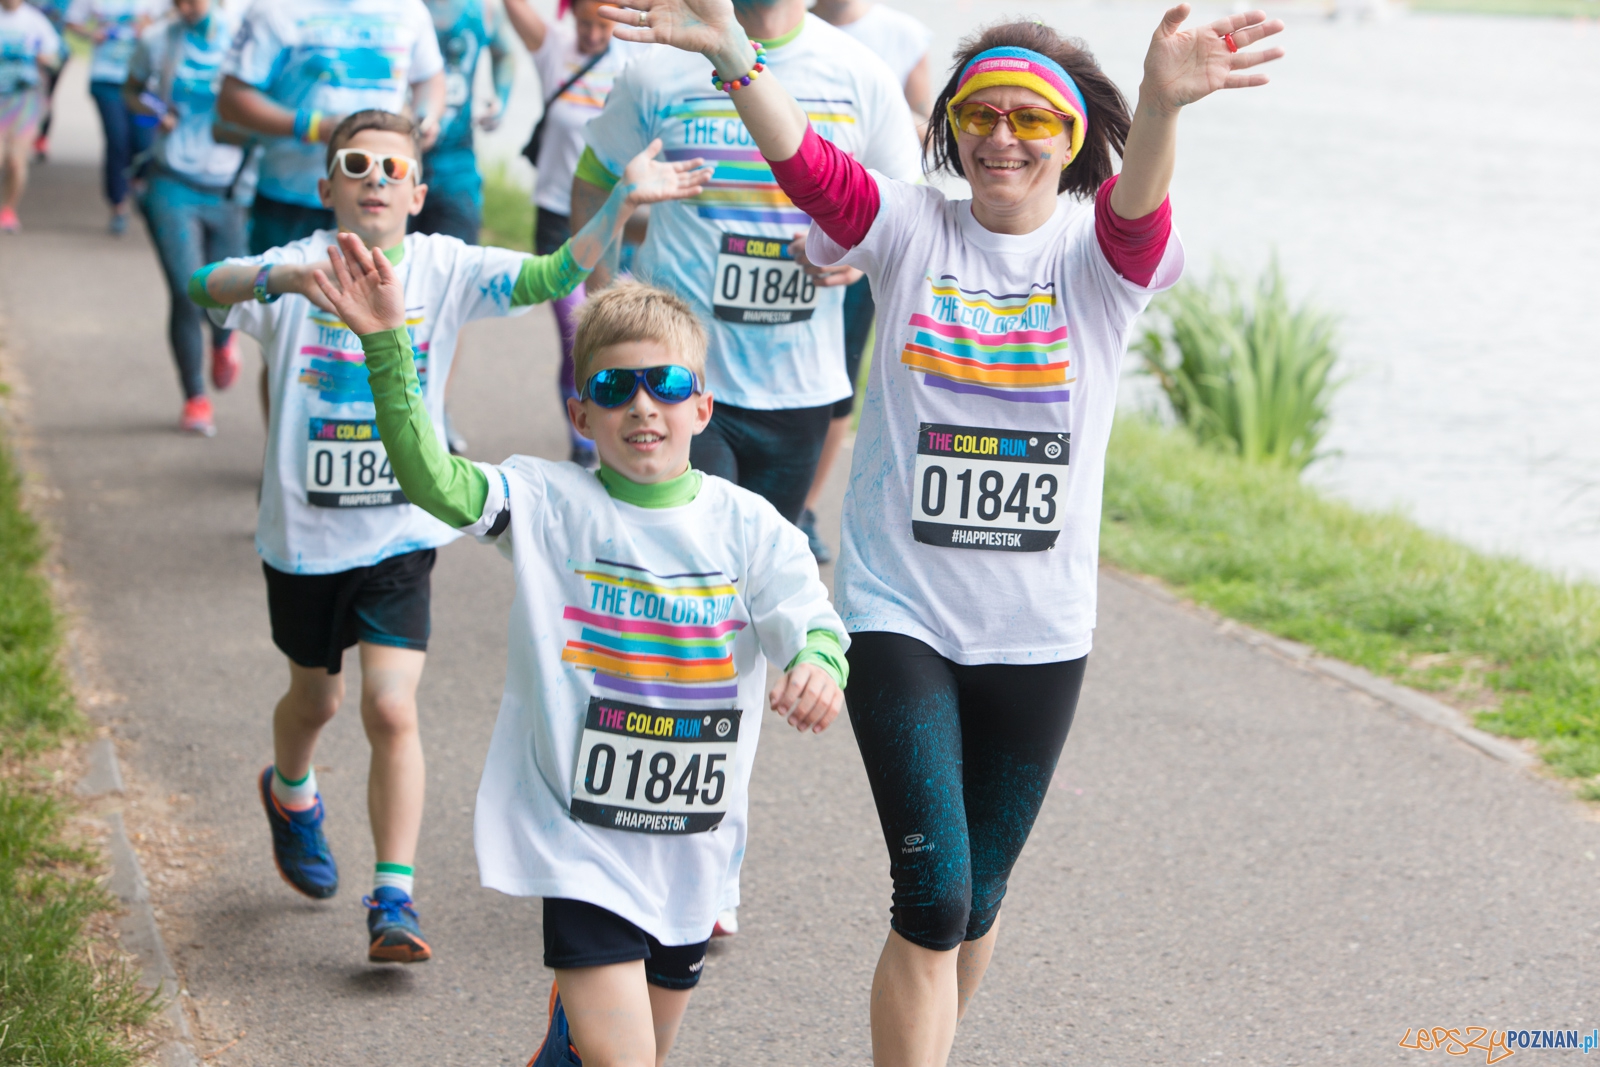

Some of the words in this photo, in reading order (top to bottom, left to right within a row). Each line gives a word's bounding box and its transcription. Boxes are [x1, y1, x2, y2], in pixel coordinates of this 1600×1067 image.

[682, 119, 718, 144] THE
[728, 237, 746, 254] THE
[746, 239, 781, 258] COLOR
[722, 263, 816, 304] 01846
[931, 294, 961, 323] THE
[960, 306, 1019, 334] COLOR
[1020, 304, 1050, 331] RUN
[317, 324, 344, 349] THE
[336, 424, 372, 440] COLOR
[928, 431, 952, 451] THE
[953, 434, 998, 456] COLOR
[1000, 437, 1027, 457] RUN
[315, 449, 397, 487] 0184
[921, 464, 1059, 525] 01843
[951, 529, 1022, 548] #HAPPIEST5K
[591, 581, 628, 616] THE
[629, 590, 699, 624] COLOR
[598, 706, 625, 729] THE
[626, 711, 674, 738] COLOR
[675, 718, 701, 739] RUN
[584, 743, 728, 806] 01845
[614, 810, 688, 832] #HAPPIEST5K
